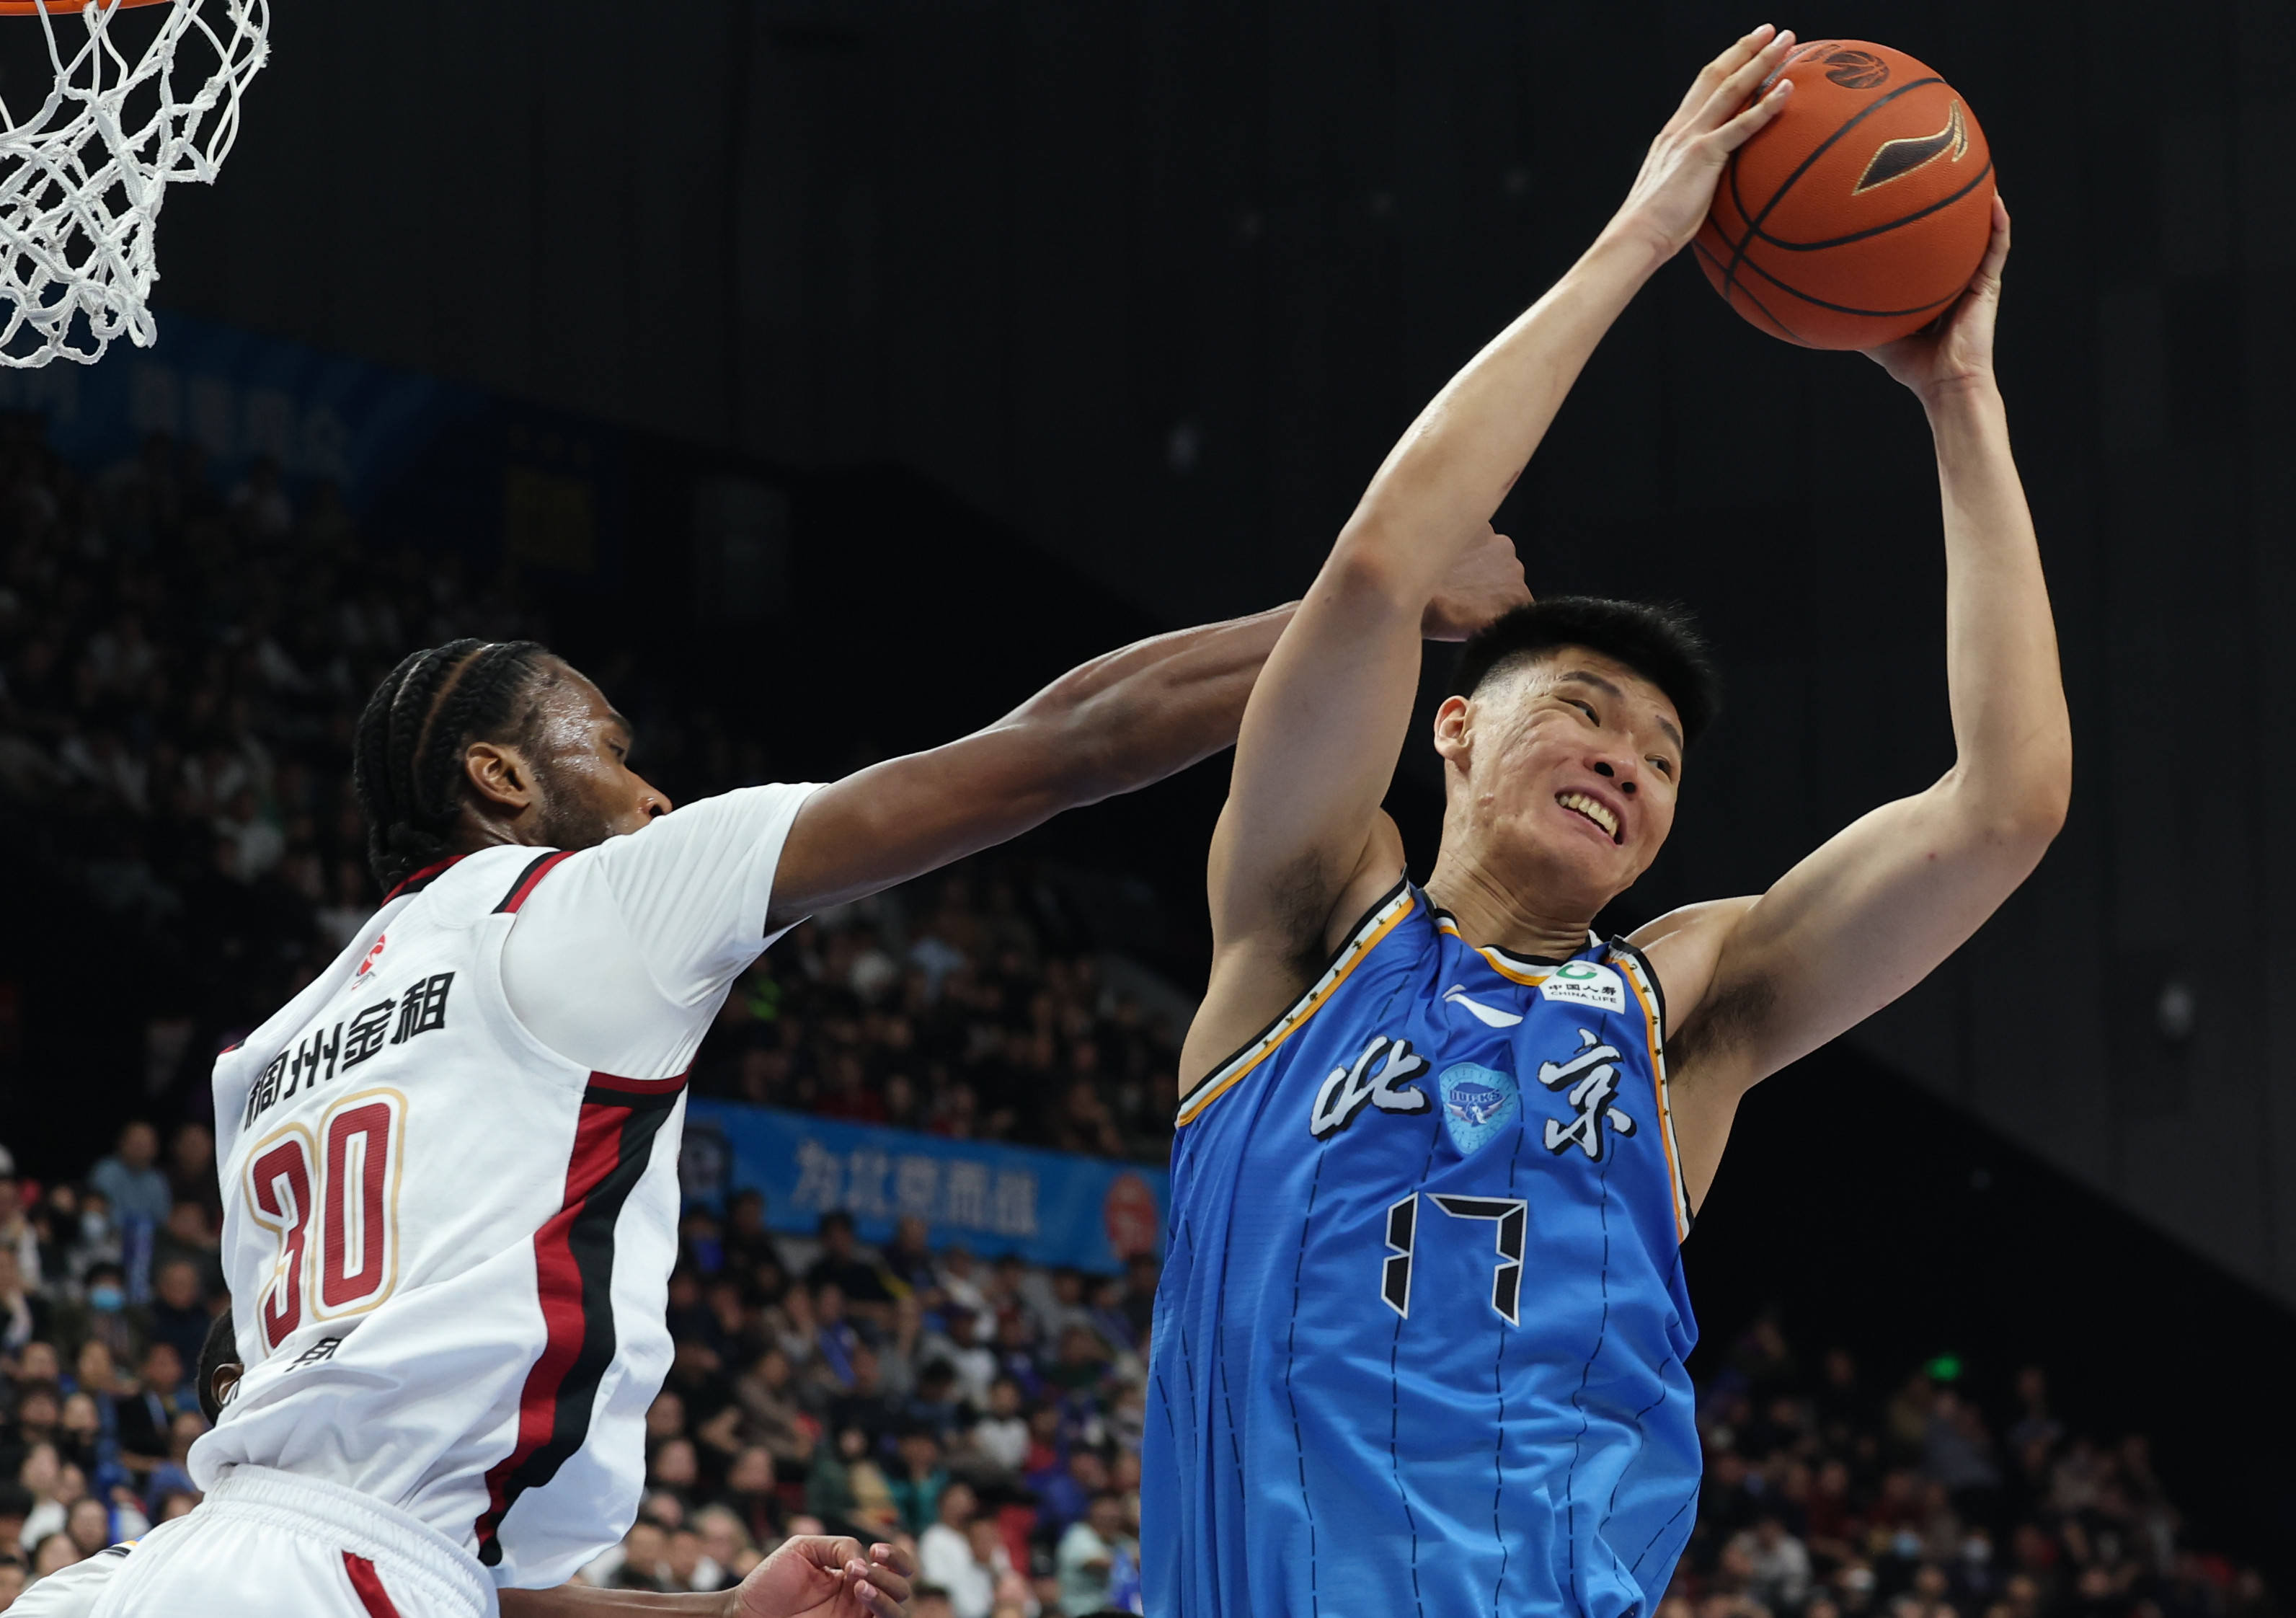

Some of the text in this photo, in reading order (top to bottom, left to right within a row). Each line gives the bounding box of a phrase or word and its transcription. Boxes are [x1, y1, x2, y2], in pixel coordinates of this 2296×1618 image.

[1548, 983, 1616, 996] 中国人寿
[1309, 1027, 1637, 1162] 北京
[245, 1091, 404, 1354] 30
[1381, 1191, 1528, 1327] 17
